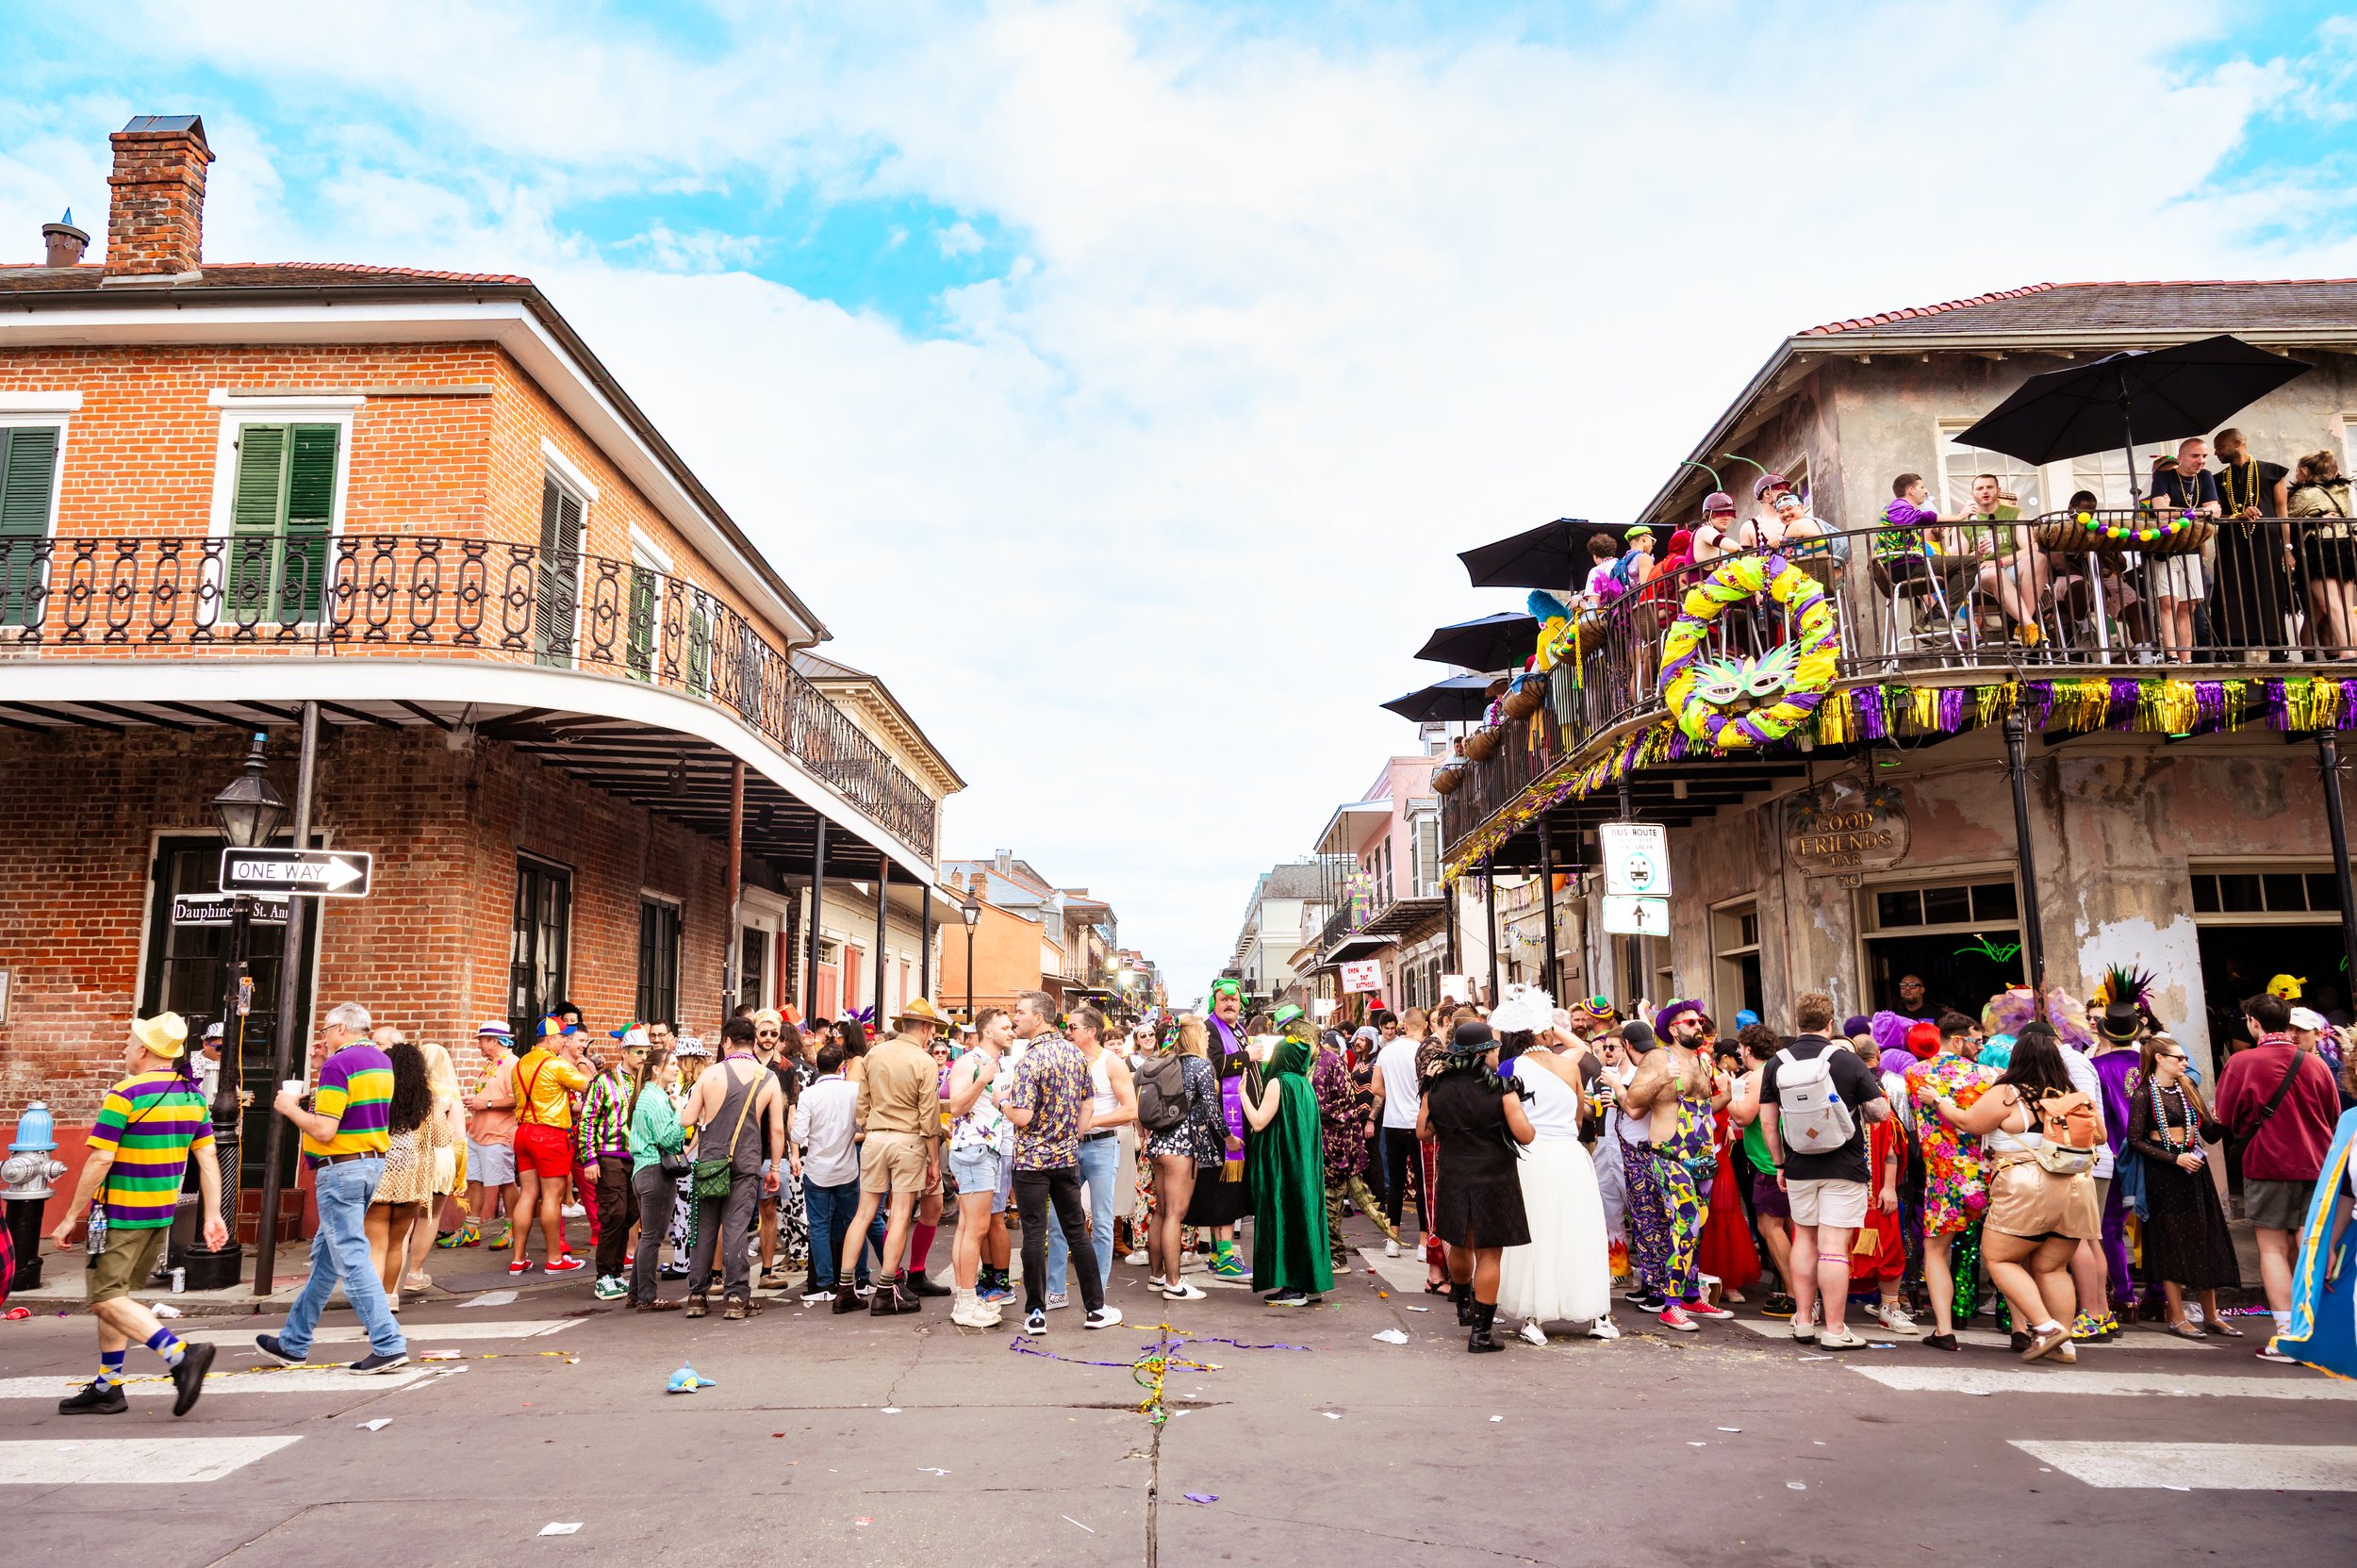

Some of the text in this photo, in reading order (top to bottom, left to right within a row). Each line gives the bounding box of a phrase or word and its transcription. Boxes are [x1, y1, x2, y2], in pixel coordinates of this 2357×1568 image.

[1815, 810, 1873, 834] GOOD
[1633, 829, 1657, 837] ROUTE
[1800, 829, 1893, 856] FRIENDS
[1831, 852, 1862, 867] BAR
[238, 862, 324, 881] ONE WAY
[1838, 874, 1858, 886] 740
[175, 903, 234, 920] Dauphine
[253, 902, 267, 917] St.
